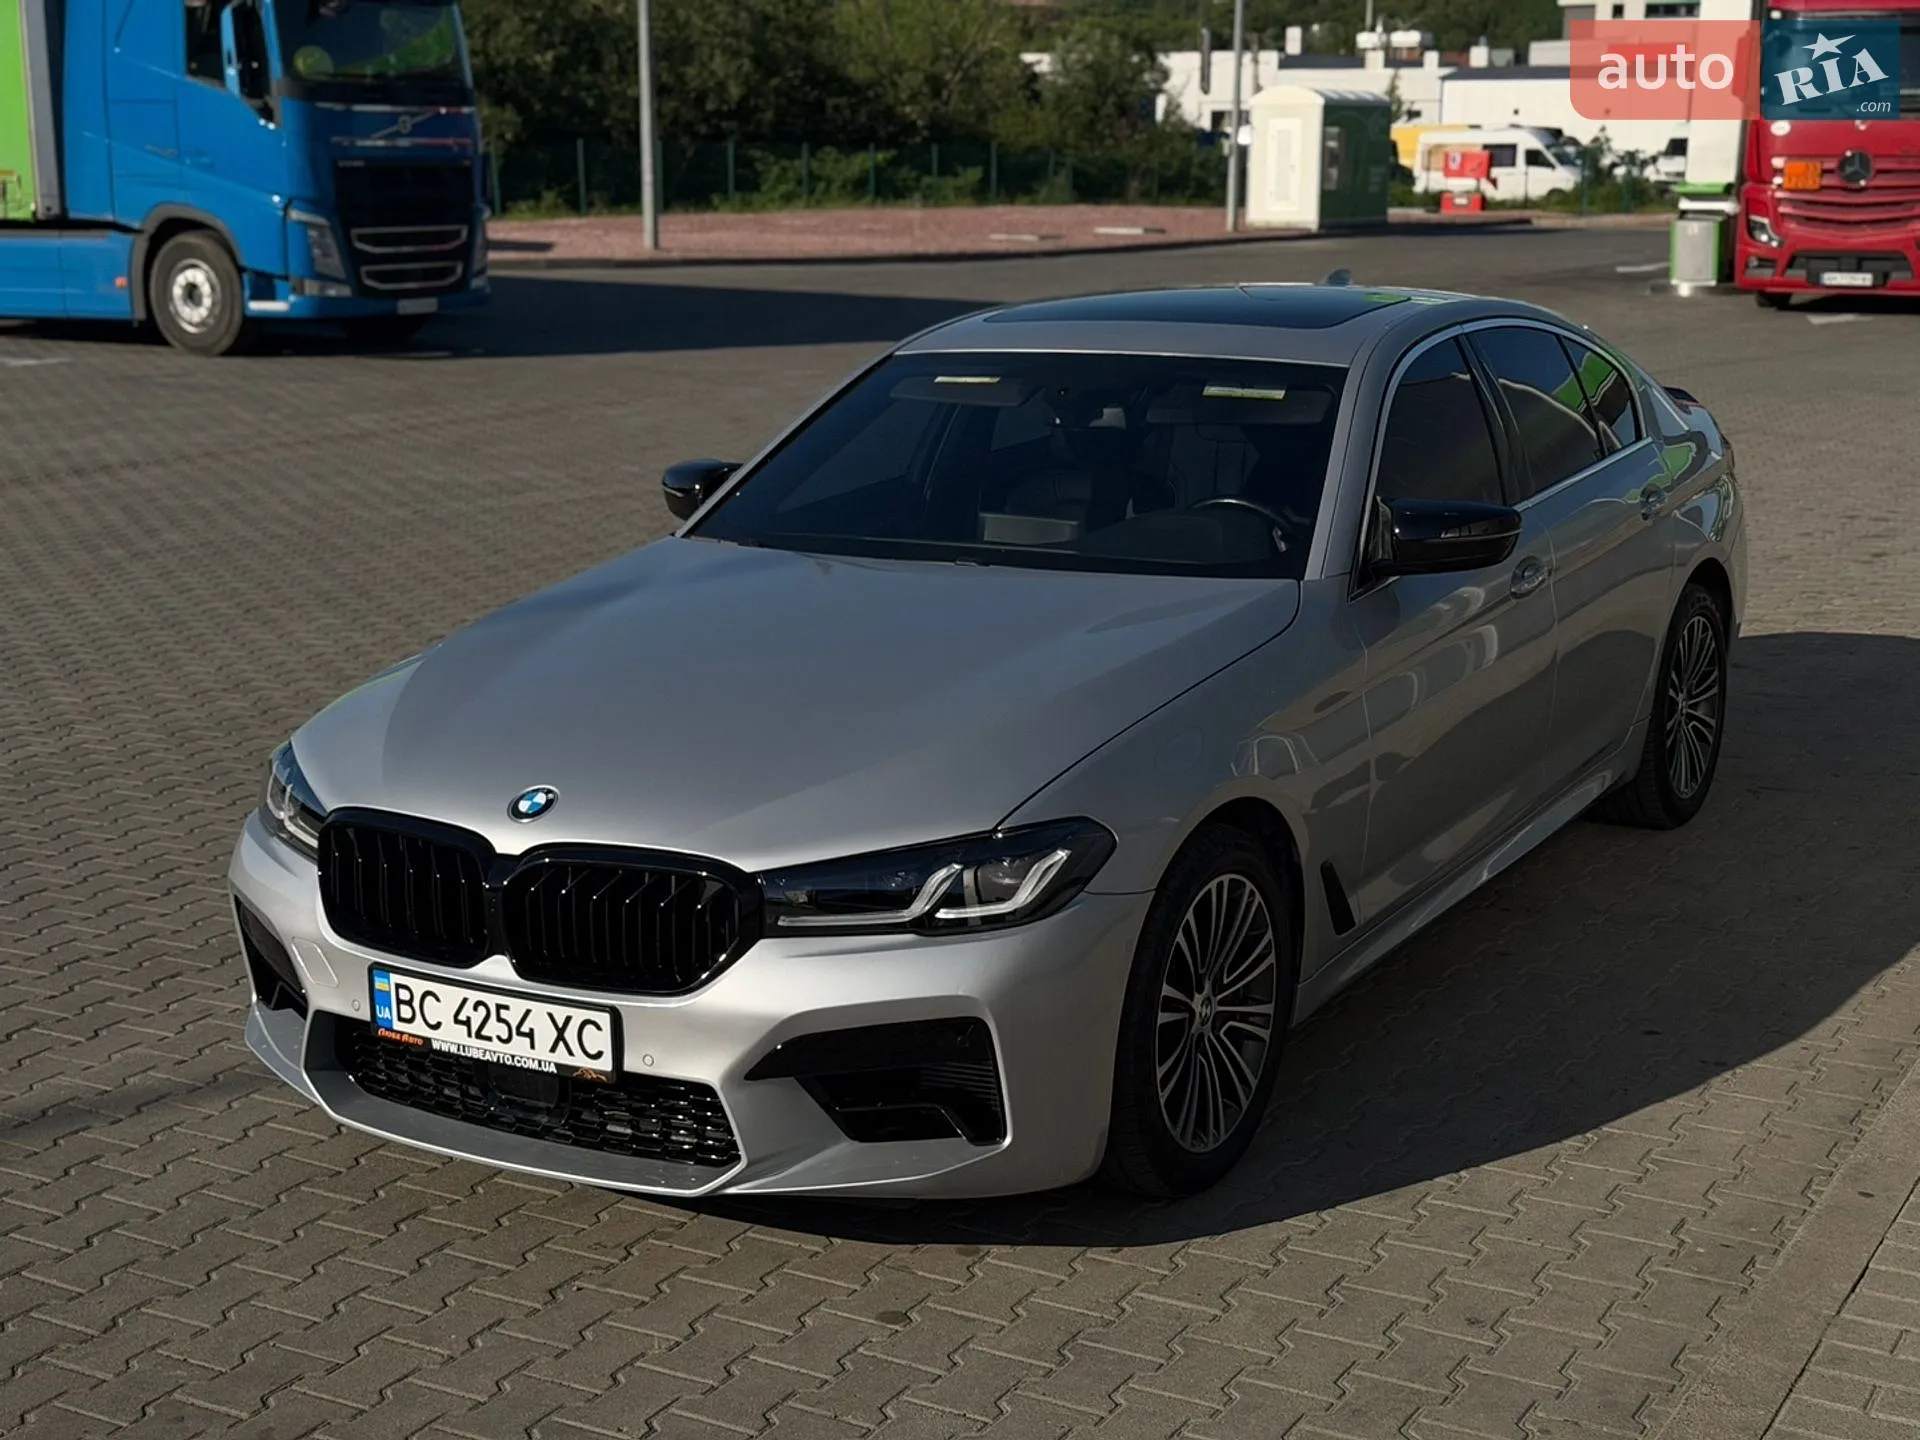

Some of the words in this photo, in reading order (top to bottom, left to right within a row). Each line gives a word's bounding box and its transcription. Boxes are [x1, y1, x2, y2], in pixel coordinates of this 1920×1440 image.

[376, 1004, 391, 1020] UA
[395, 982, 443, 1031] BC
[453, 996, 535, 1051] 4254
[546, 1011, 604, 1061] XC
[431, 1038, 558, 1074] WWW.LUBEAVTO.COM.UA
